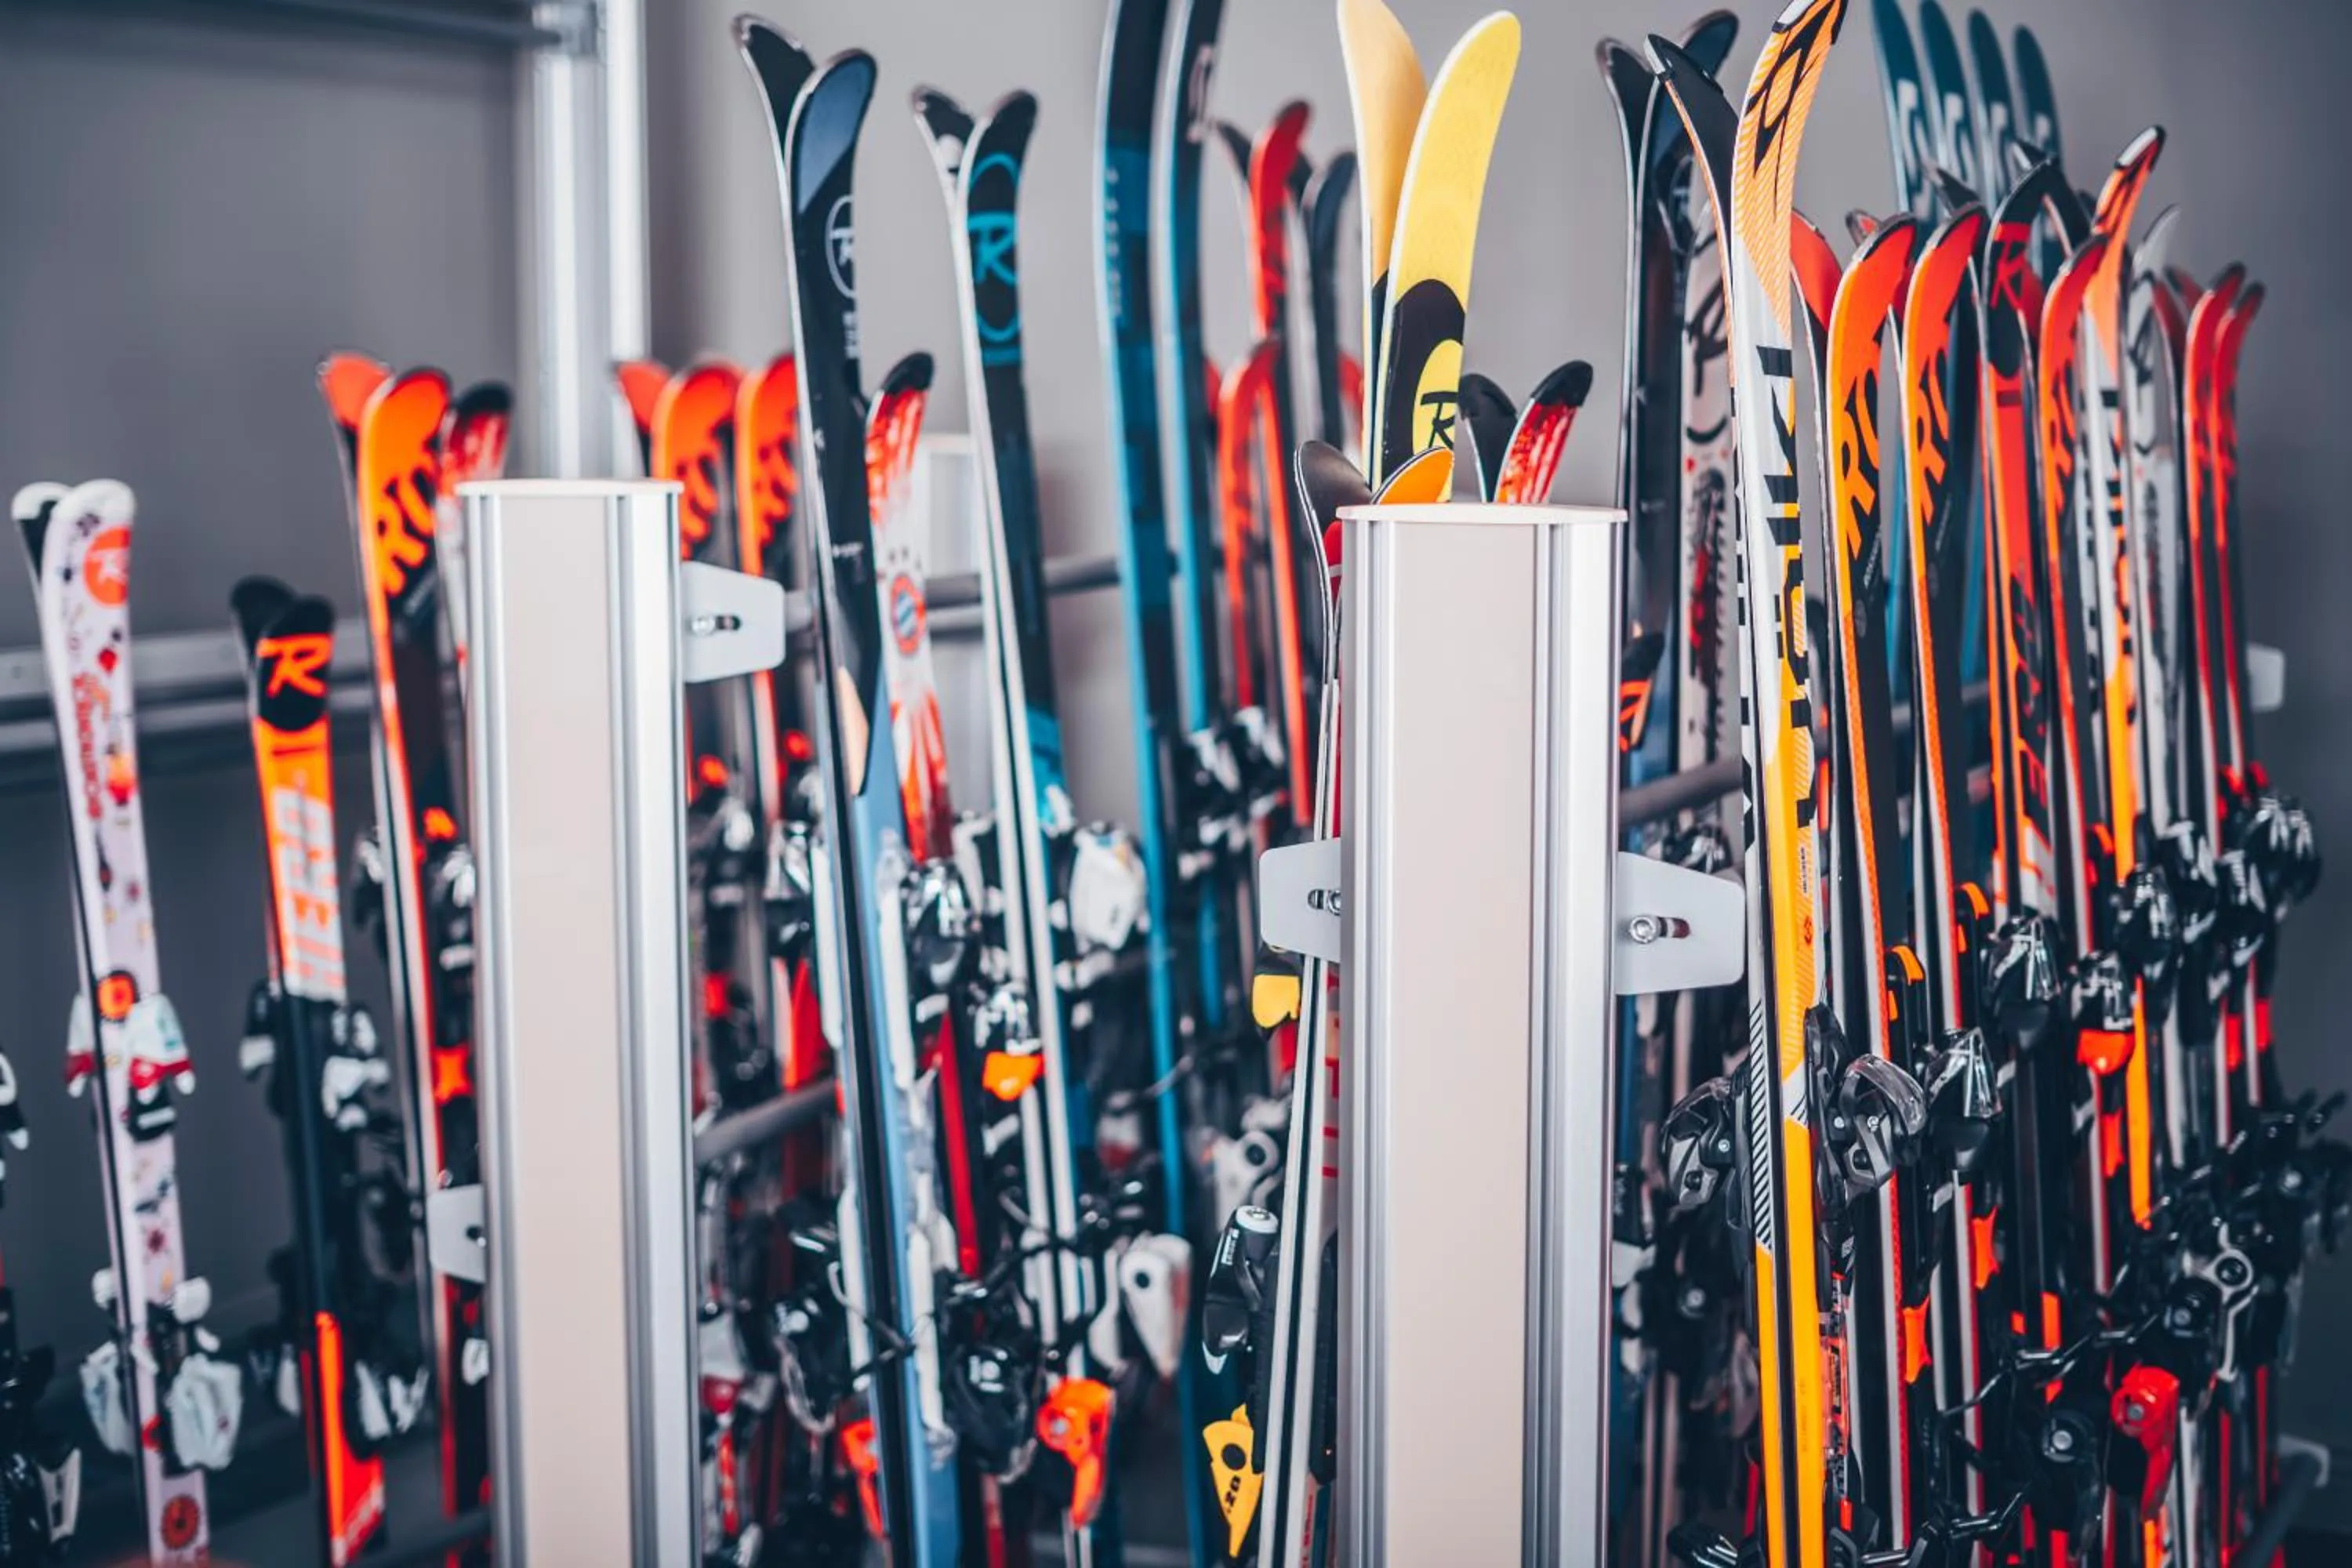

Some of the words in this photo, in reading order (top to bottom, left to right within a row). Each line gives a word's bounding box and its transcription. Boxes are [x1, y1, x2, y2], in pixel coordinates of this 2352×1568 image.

[967, 212, 1018, 286] R
[256, 633, 333, 698] R
[271, 786, 347, 999] HERO
